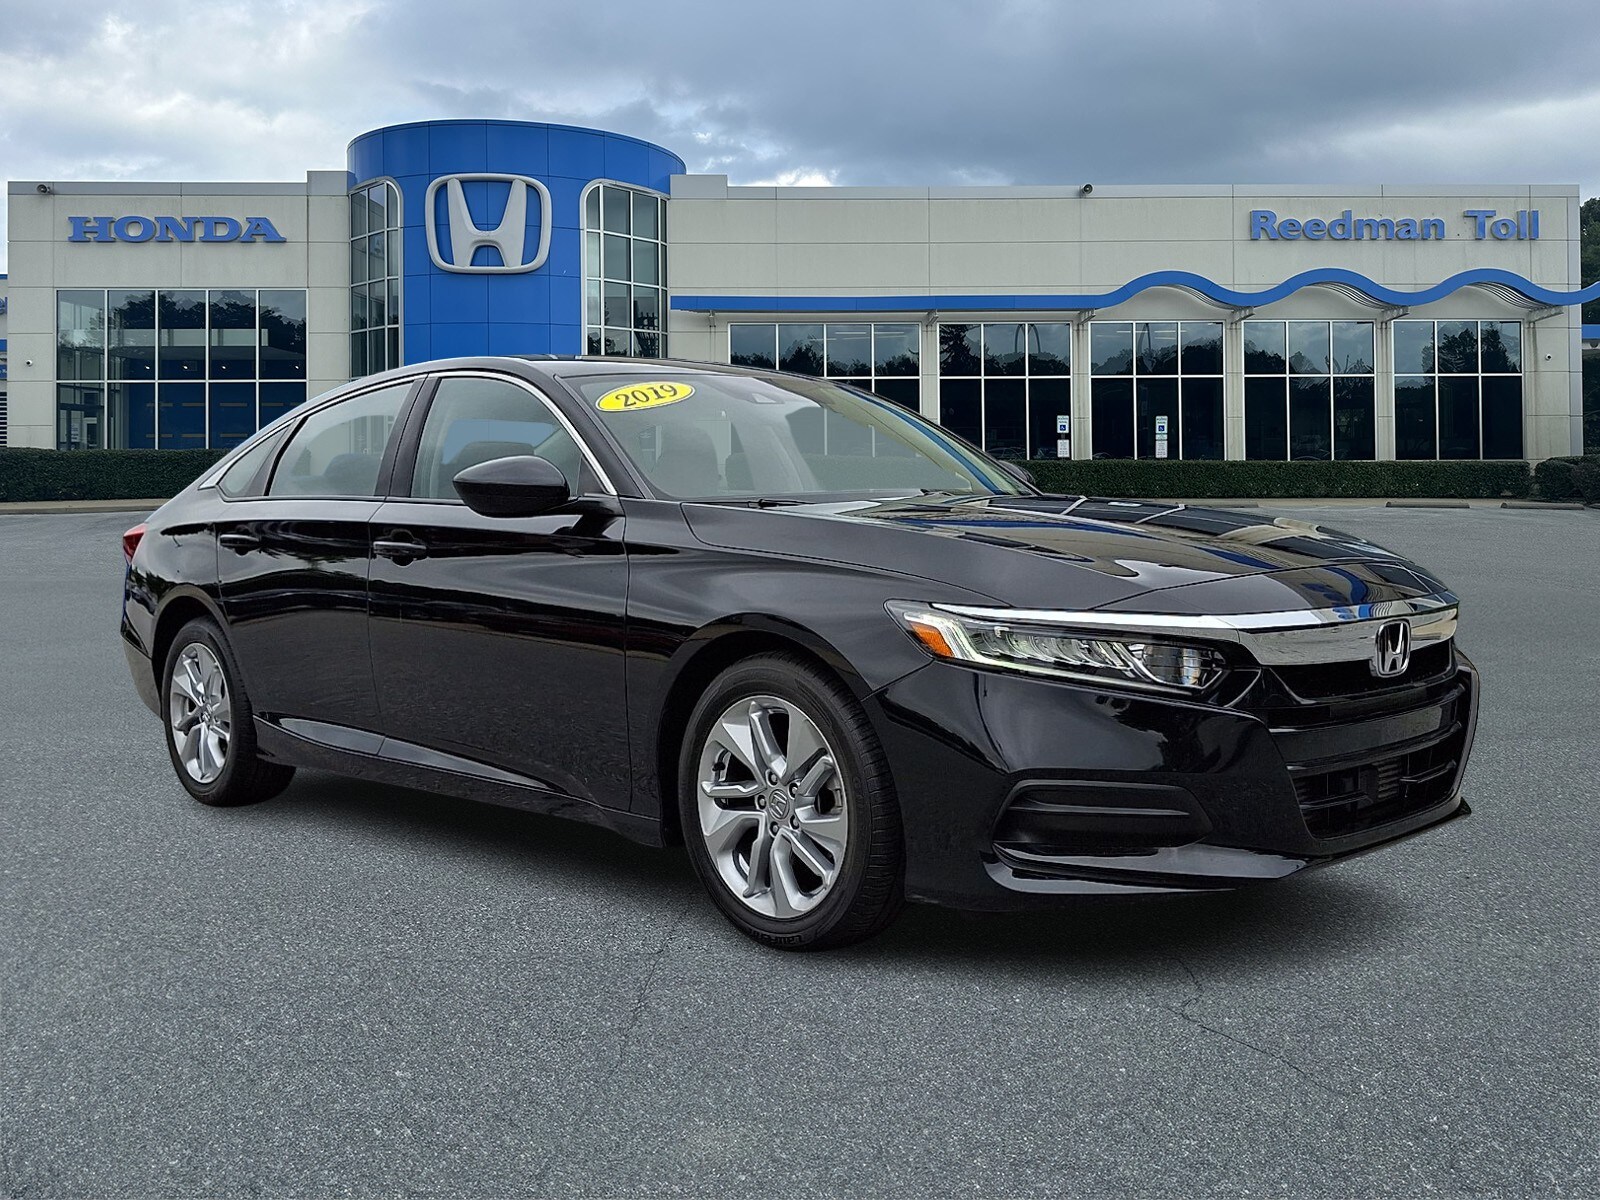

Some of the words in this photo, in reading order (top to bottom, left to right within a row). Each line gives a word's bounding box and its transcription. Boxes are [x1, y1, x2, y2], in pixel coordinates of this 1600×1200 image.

[68, 216, 287, 243] HONDA
[1250, 210, 1446, 240] Reedman
[1464, 210, 1540, 240] Toll
[615, 384, 678, 407] 2019
